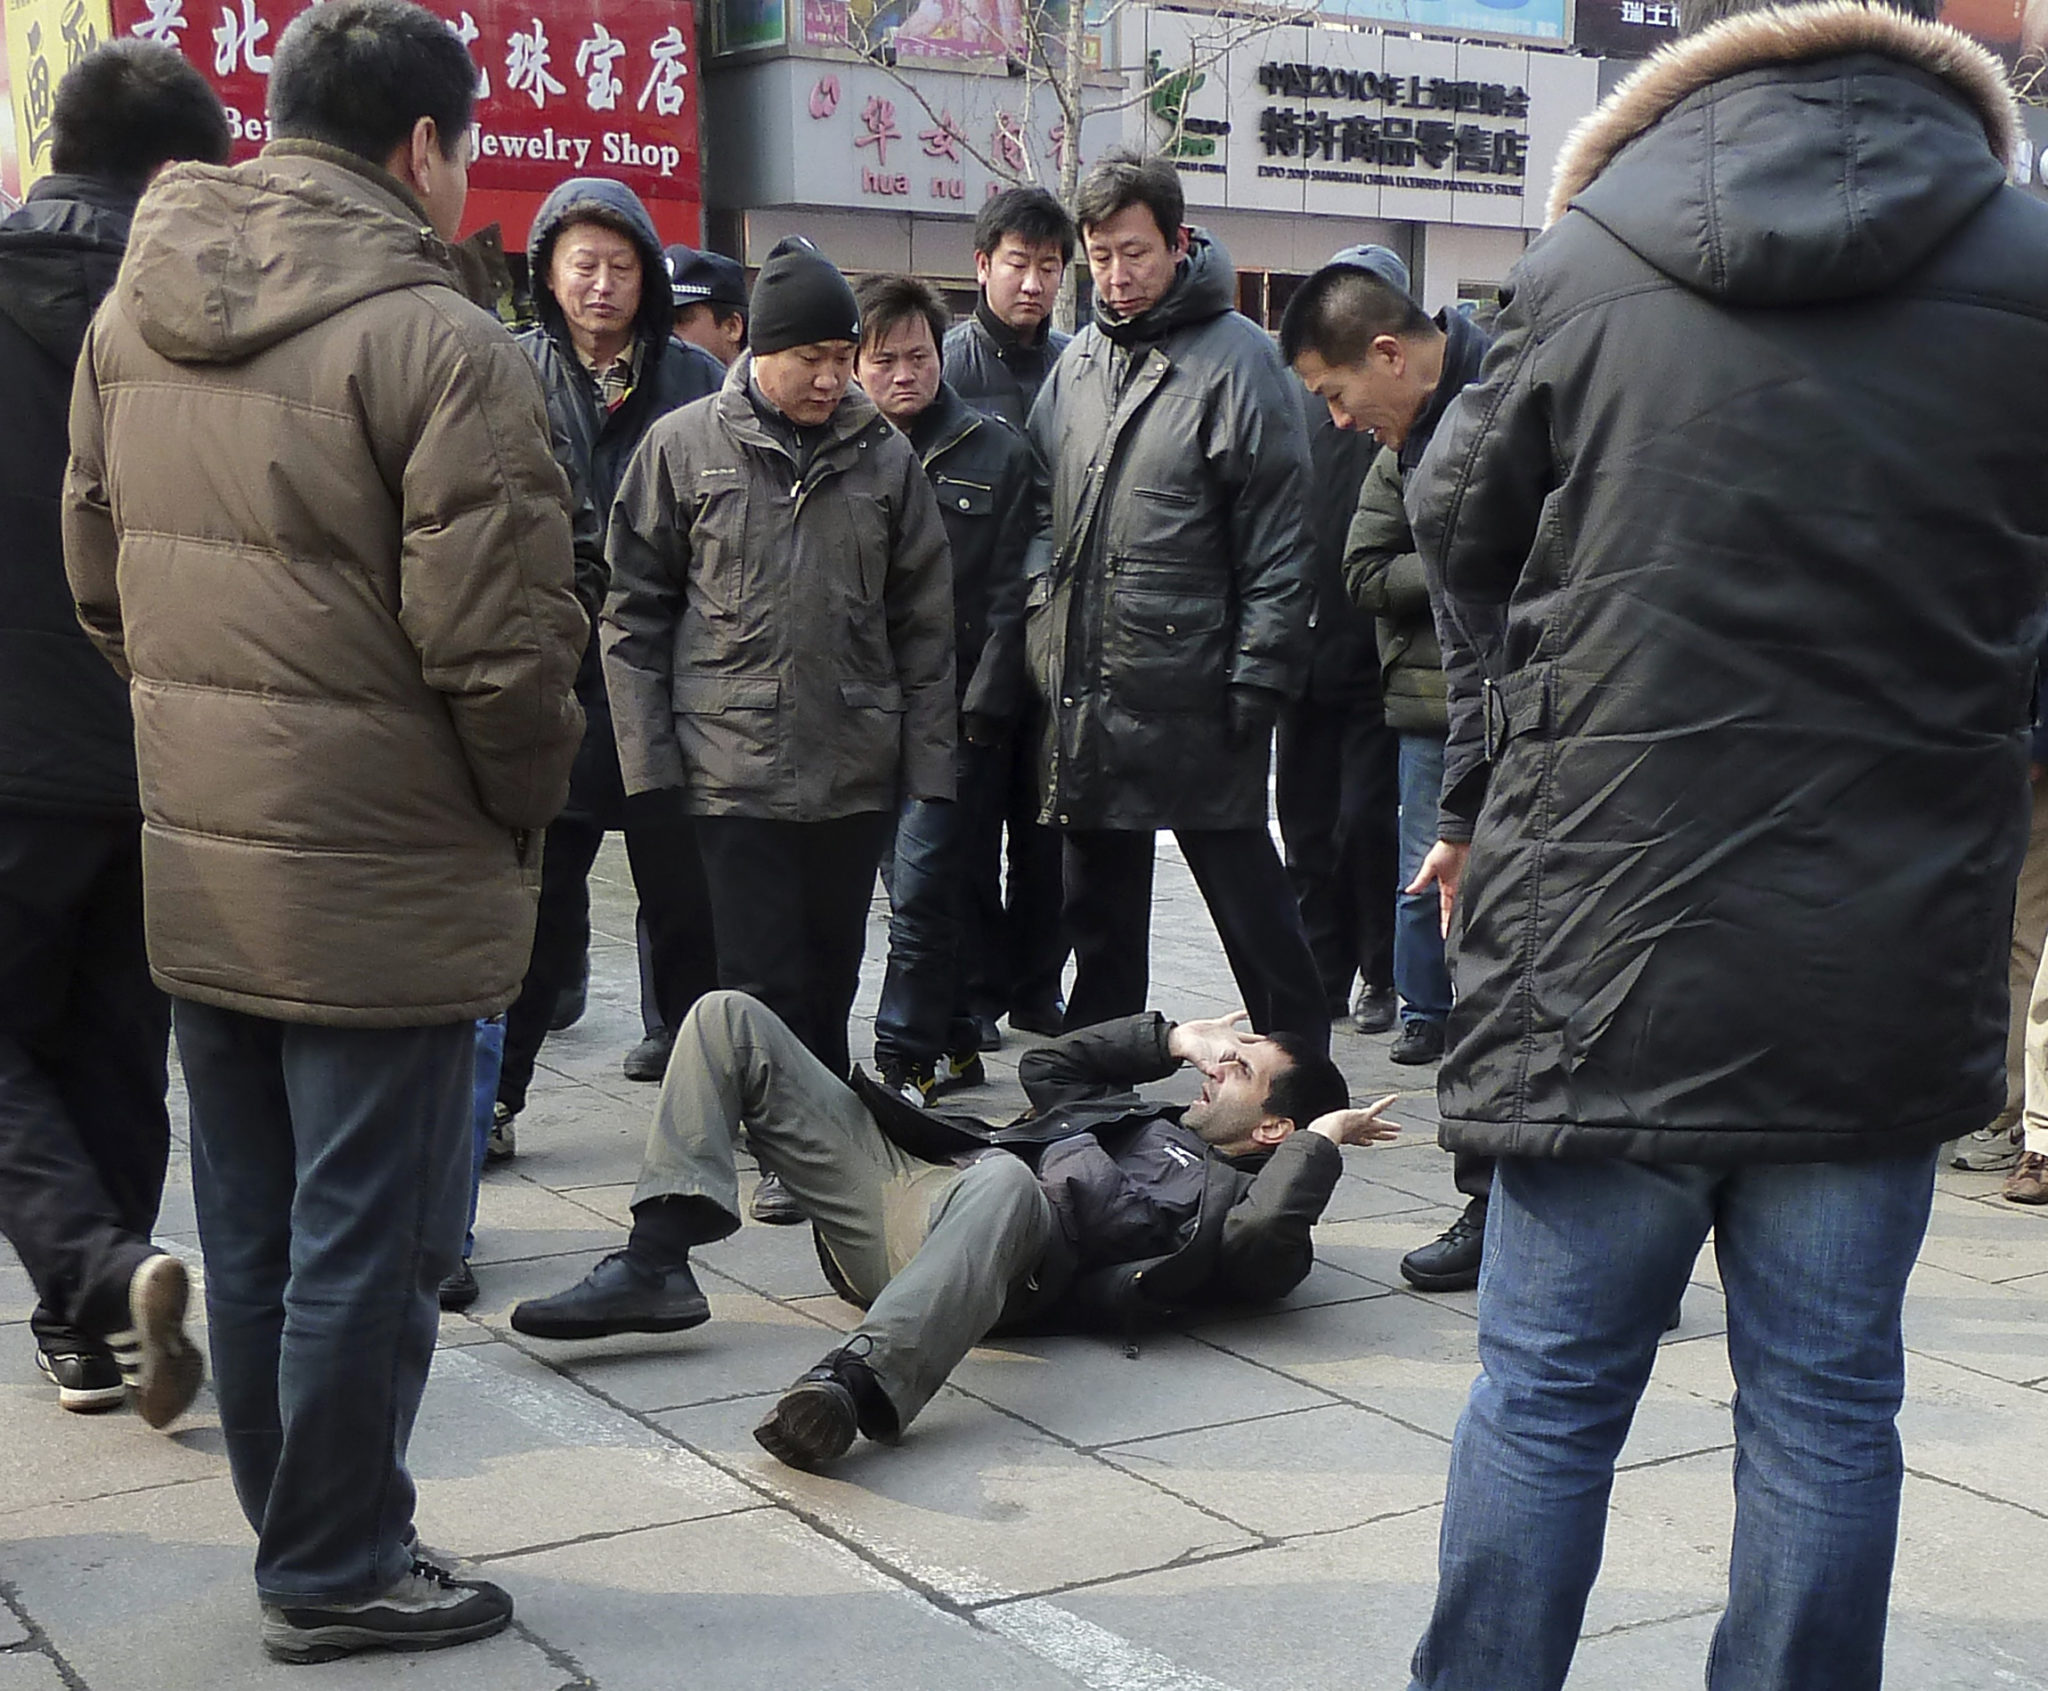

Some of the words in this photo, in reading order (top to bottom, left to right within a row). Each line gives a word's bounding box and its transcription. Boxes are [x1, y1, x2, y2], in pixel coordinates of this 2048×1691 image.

[223, 107, 273, 141] Bei
[470, 122, 591, 169] Jewelry
[603, 132, 680, 176] Shop
[1259, 106, 1530, 176] 特许商品零售店
[862, 166, 910, 195] hua
[931, 176, 964, 199] nu
